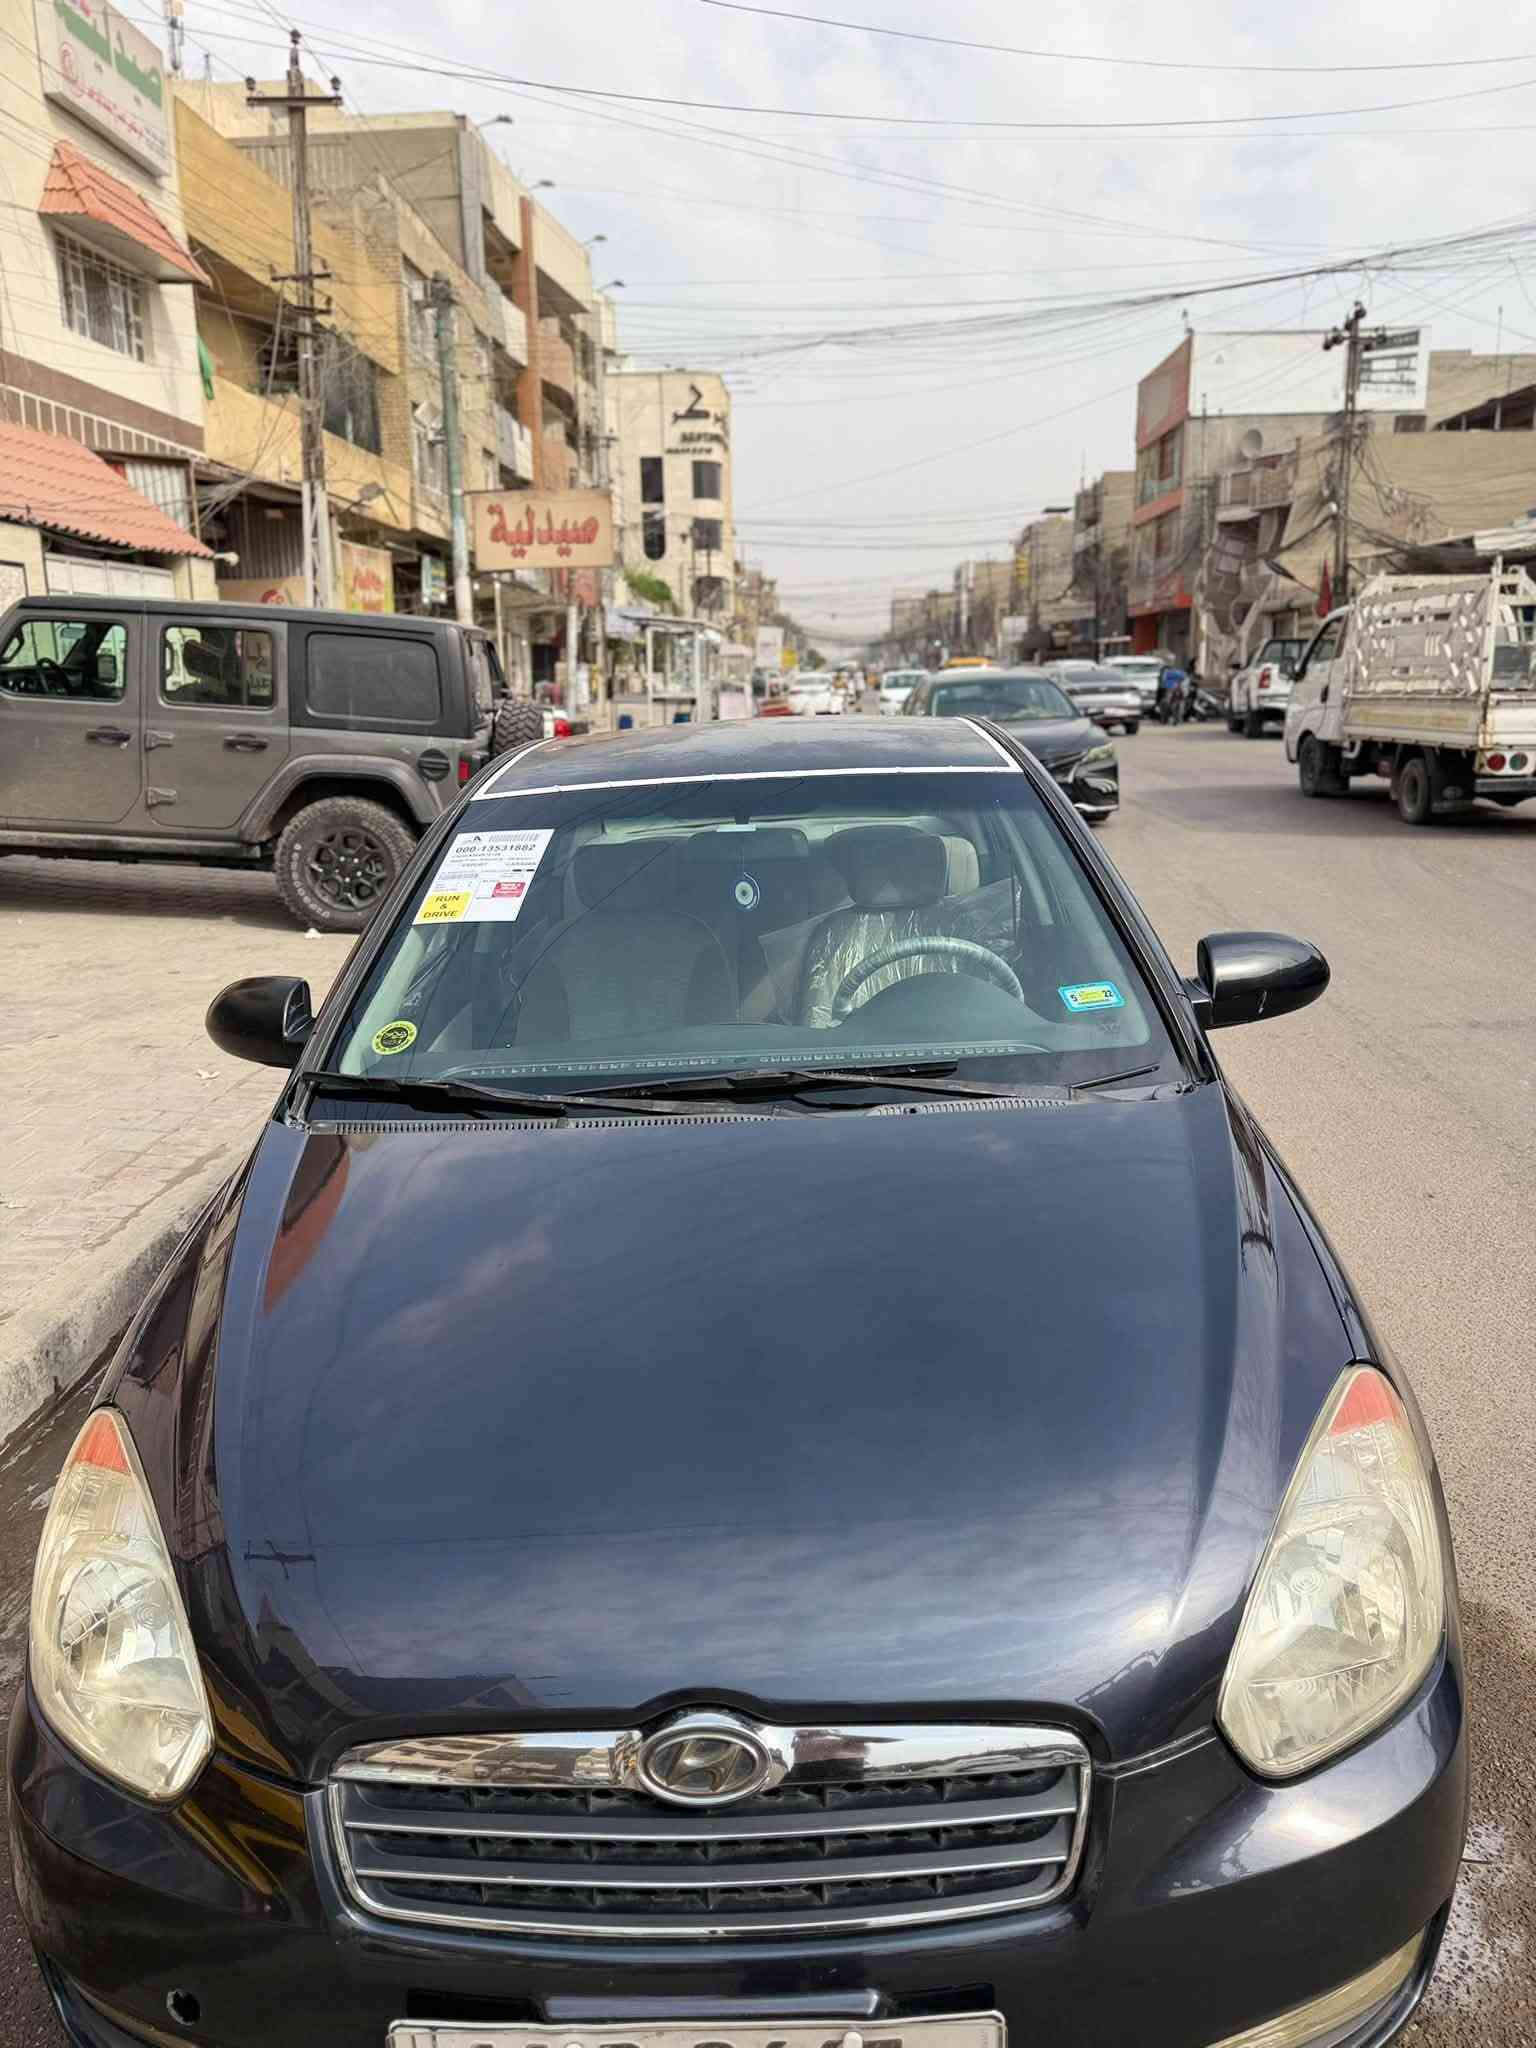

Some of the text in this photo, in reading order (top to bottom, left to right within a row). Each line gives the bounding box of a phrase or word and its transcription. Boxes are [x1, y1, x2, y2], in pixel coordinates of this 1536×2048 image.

[487, 503, 600, 559] صيدلية
[435, 895, 461, 903] RUN
[423, 910, 458, 918] DRIVE
